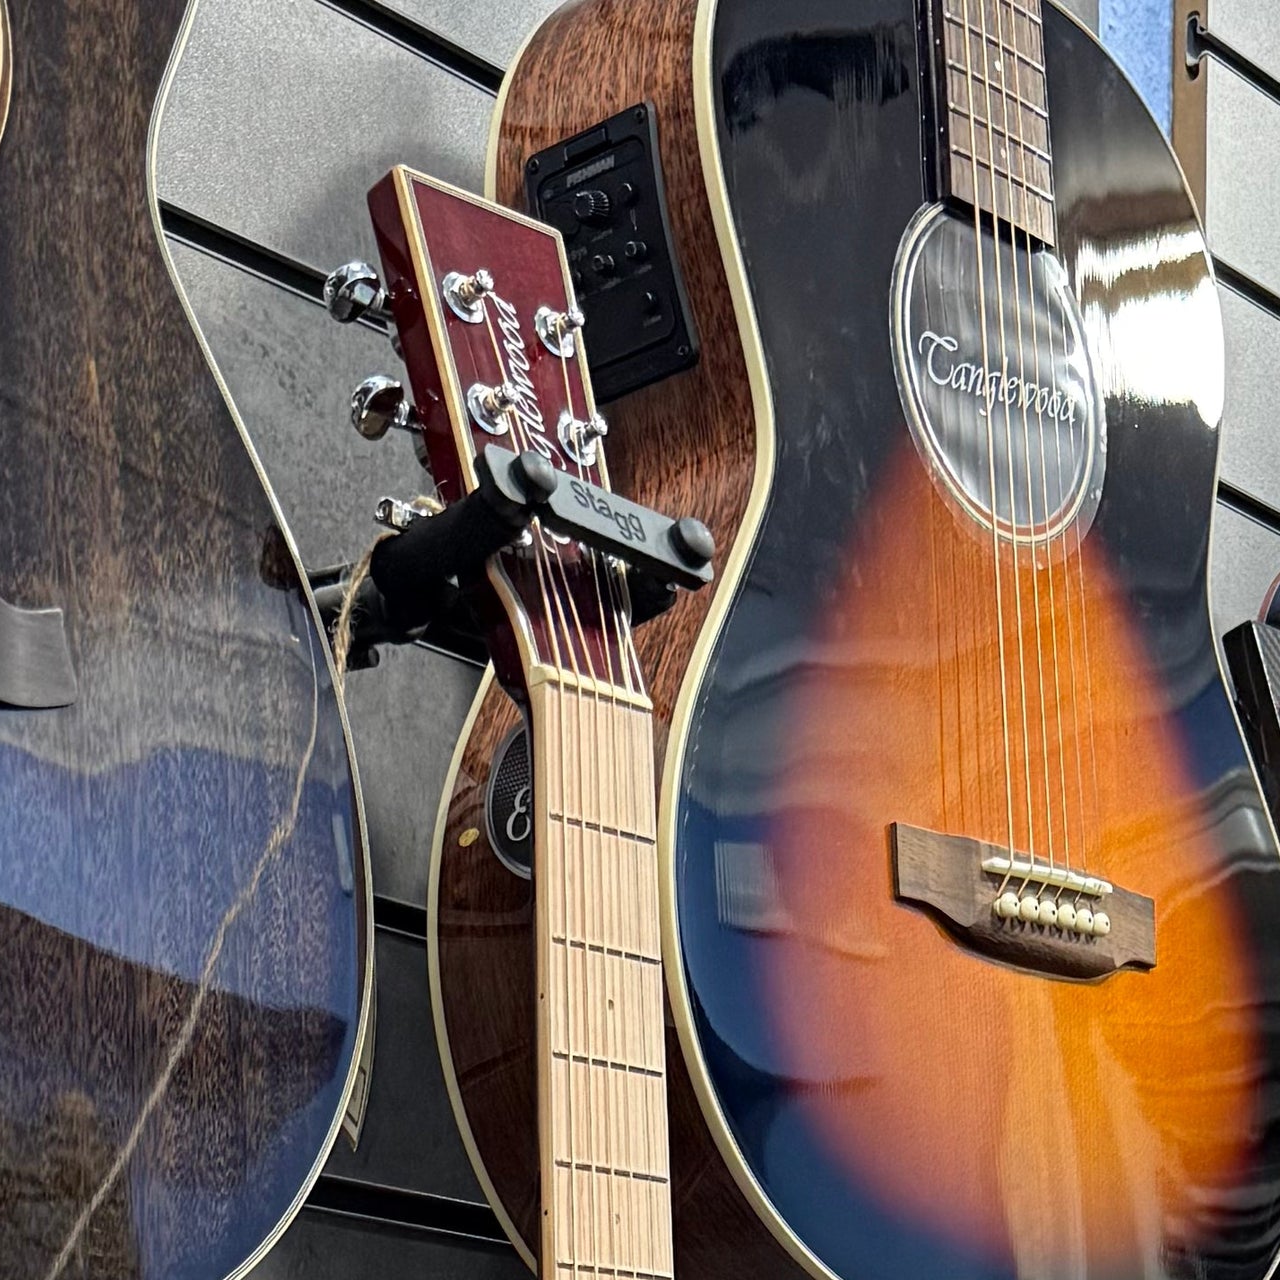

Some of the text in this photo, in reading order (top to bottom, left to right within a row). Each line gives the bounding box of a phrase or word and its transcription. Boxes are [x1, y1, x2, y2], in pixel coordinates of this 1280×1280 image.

[486, 290, 568, 474] glewood
[918, 330, 1077, 422] Tanglewood
[569, 480, 647, 543] Stagg
